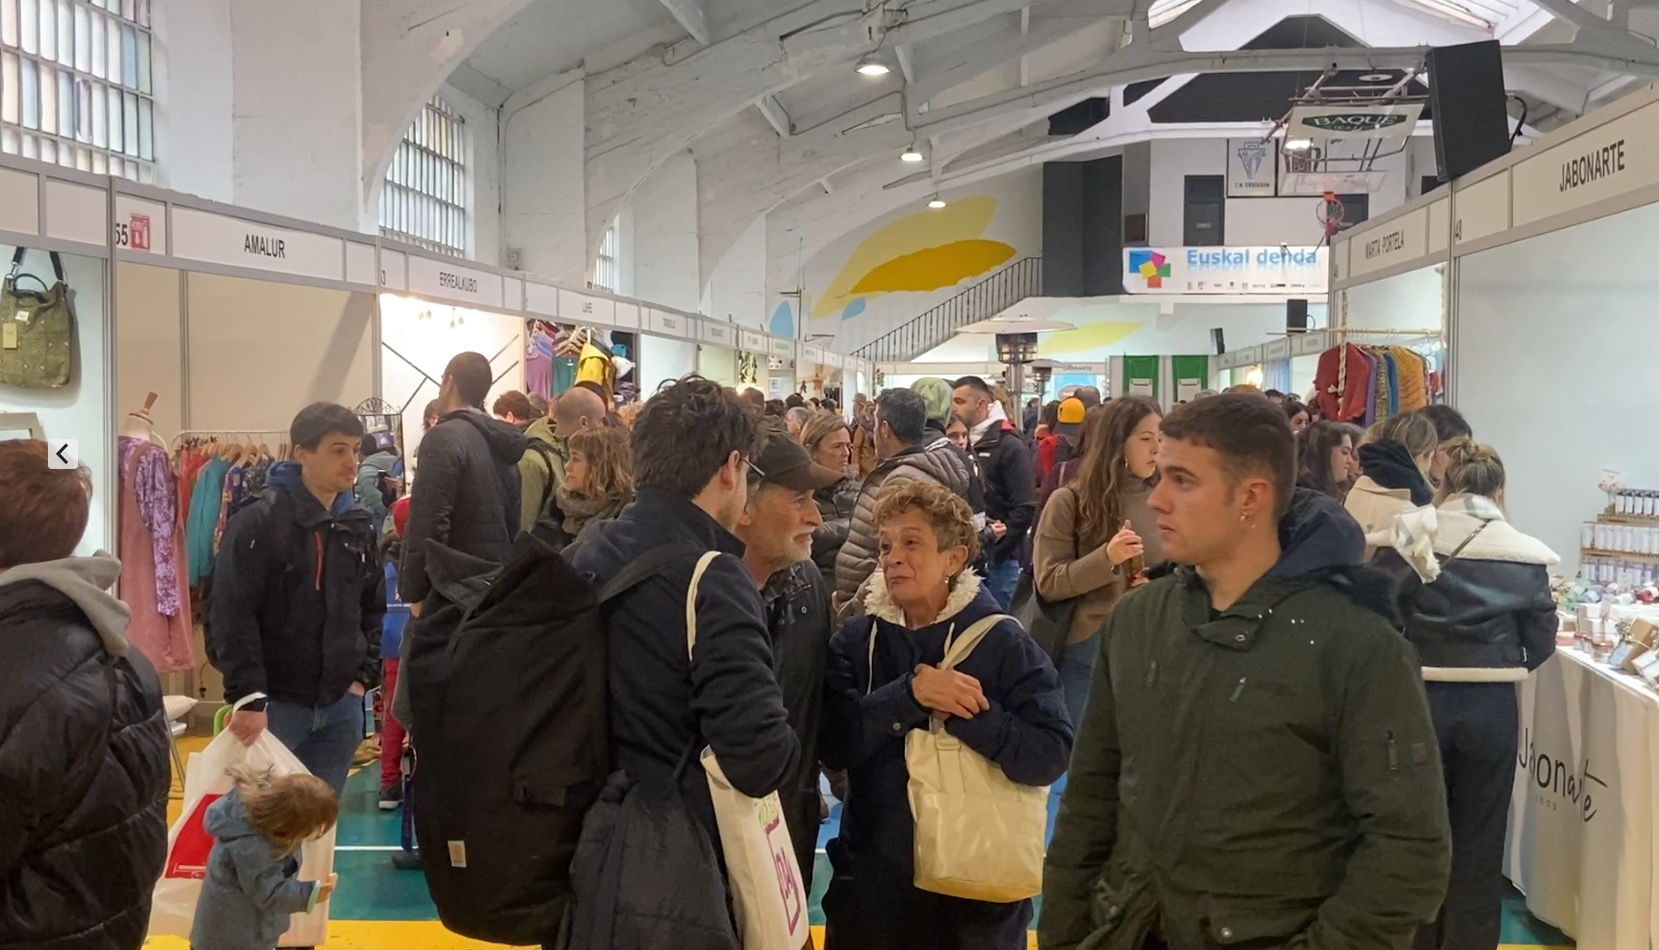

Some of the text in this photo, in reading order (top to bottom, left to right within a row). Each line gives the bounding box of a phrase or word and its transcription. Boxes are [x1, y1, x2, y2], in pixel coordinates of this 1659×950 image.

[1559, 138, 1625, 192] JABONARTE
[243, 233, 286, 259] AMALUR
[1187, 248, 1317, 265] Euskal denda
